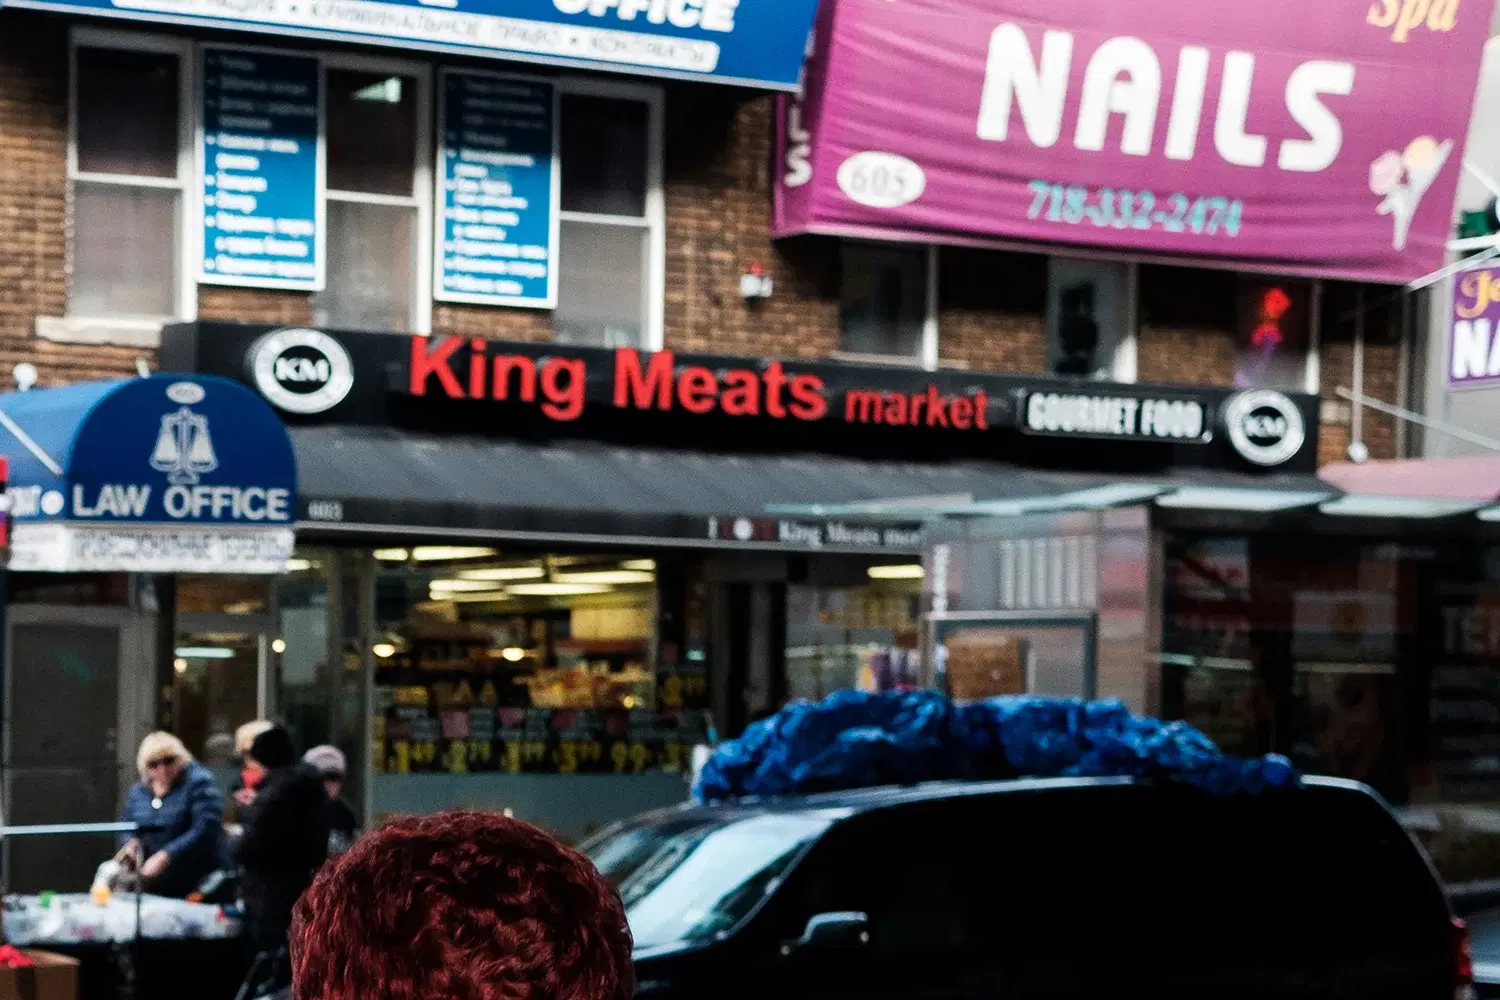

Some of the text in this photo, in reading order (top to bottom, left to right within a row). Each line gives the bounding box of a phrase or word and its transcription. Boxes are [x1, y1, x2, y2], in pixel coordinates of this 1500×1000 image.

[976, 22, 1356, 172] NAILS
[849, 163, 908, 199] 605
[275, 356, 329, 382] KM
[1452, 318, 1500, 379] N
[409, 335, 990, 430] King Meats market
[1027, 392, 1203, 438] GOURMET FOOD
[72, 484, 151, 518] LAW
[162, 485, 291, 521] OFFICE
